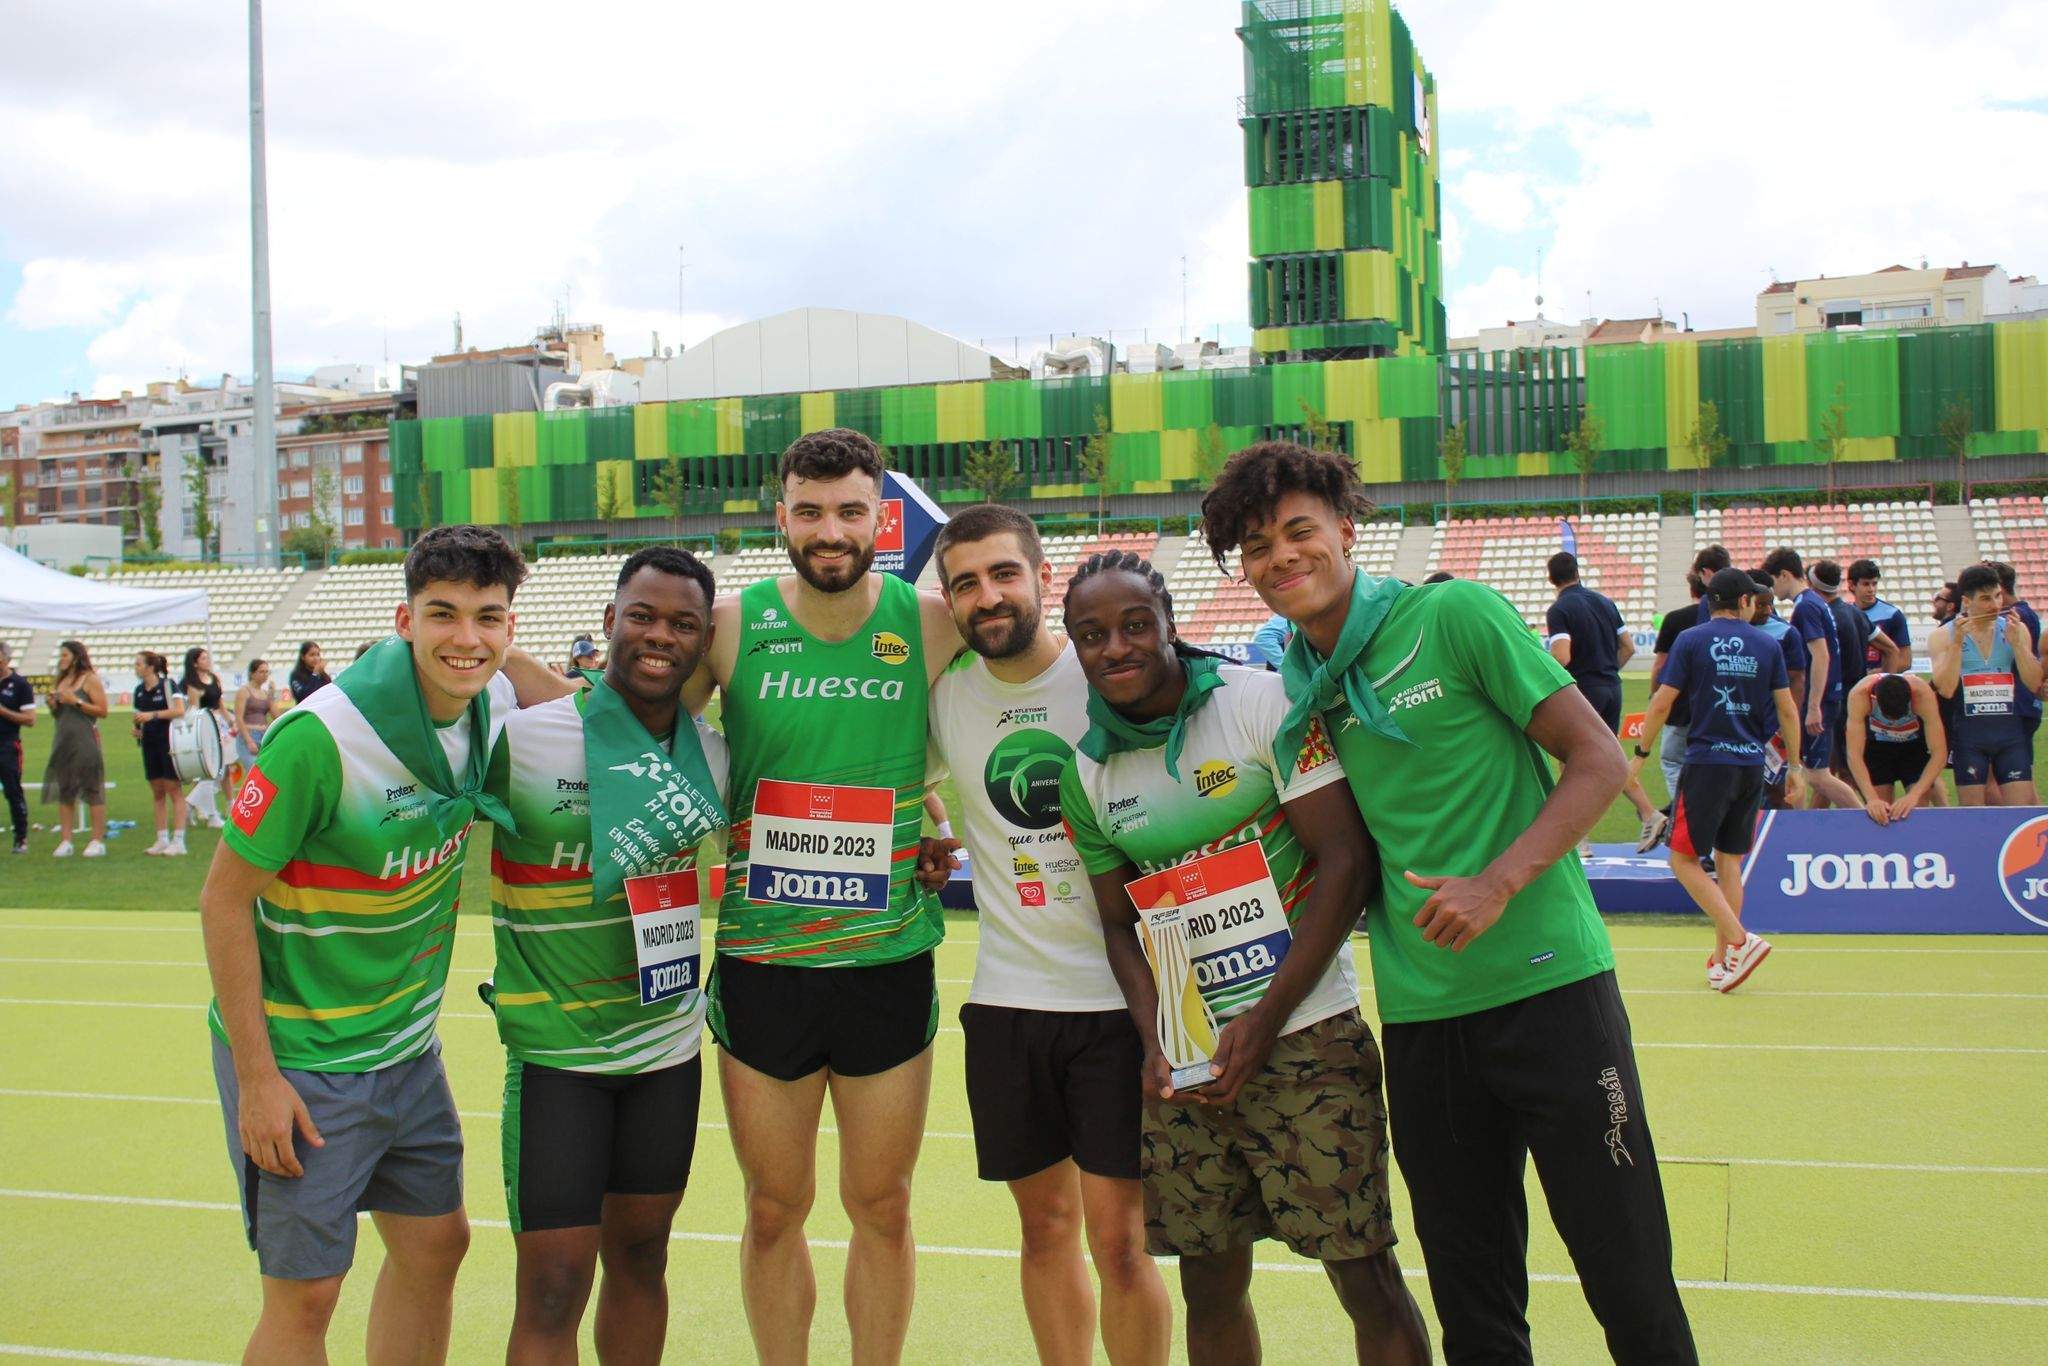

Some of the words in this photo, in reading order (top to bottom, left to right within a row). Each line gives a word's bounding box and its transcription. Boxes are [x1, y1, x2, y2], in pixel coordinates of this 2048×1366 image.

[870, 561, 904, 571] Madrid
[874, 553, 904, 562] unidad
[751, 620, 788, 630] VIATOR
[769, 642, 803, 654] ZOITI
[873, 633, 909, 657] intec
[758, 670, 904, 701] Huesca
[1402, 678, 1440, 697] ATLETISMO
[1404, 684, 1443, 709] ZOITI
[1014, 706, 1047, 714] ATLETISMO
[1014, 713, 1048, 725] ZOITI
[556, 778, 590, 791] Prote
[1193, 765, 1238, 792] intec
[386, 783, 417, 801] Protex
[657, 779, 713, 836] ZOIT
[1108, 795, 1139, 814] Protex
[608, 826, 650, 867] ENTABAN
[765, 829, 829, 855] MADRID
[832, 835, 876, 858] 2023
[1008, 834, 1035, 851] que
[1038, 831, 1068, 844] corr
[610, 847, 629, 866] SIN
[1012, 857, 1040, 872] intec
[765, 869, 869, 902] Joma
[1779, 852, 1956, 897] Joma
[2022, 878, 2048, 900] Jo
[1184, 912, 1218, 941] RID
[1218, 897, 1265, 931] 2023
[642, 923, 675, 949] MADRID
[675, 919, 694, 940] 2023
[1192, 942, 1277, 987] oma
[649, 961, 692, 999] Joma
[1597, 1066, 1628, 1124] rasán
